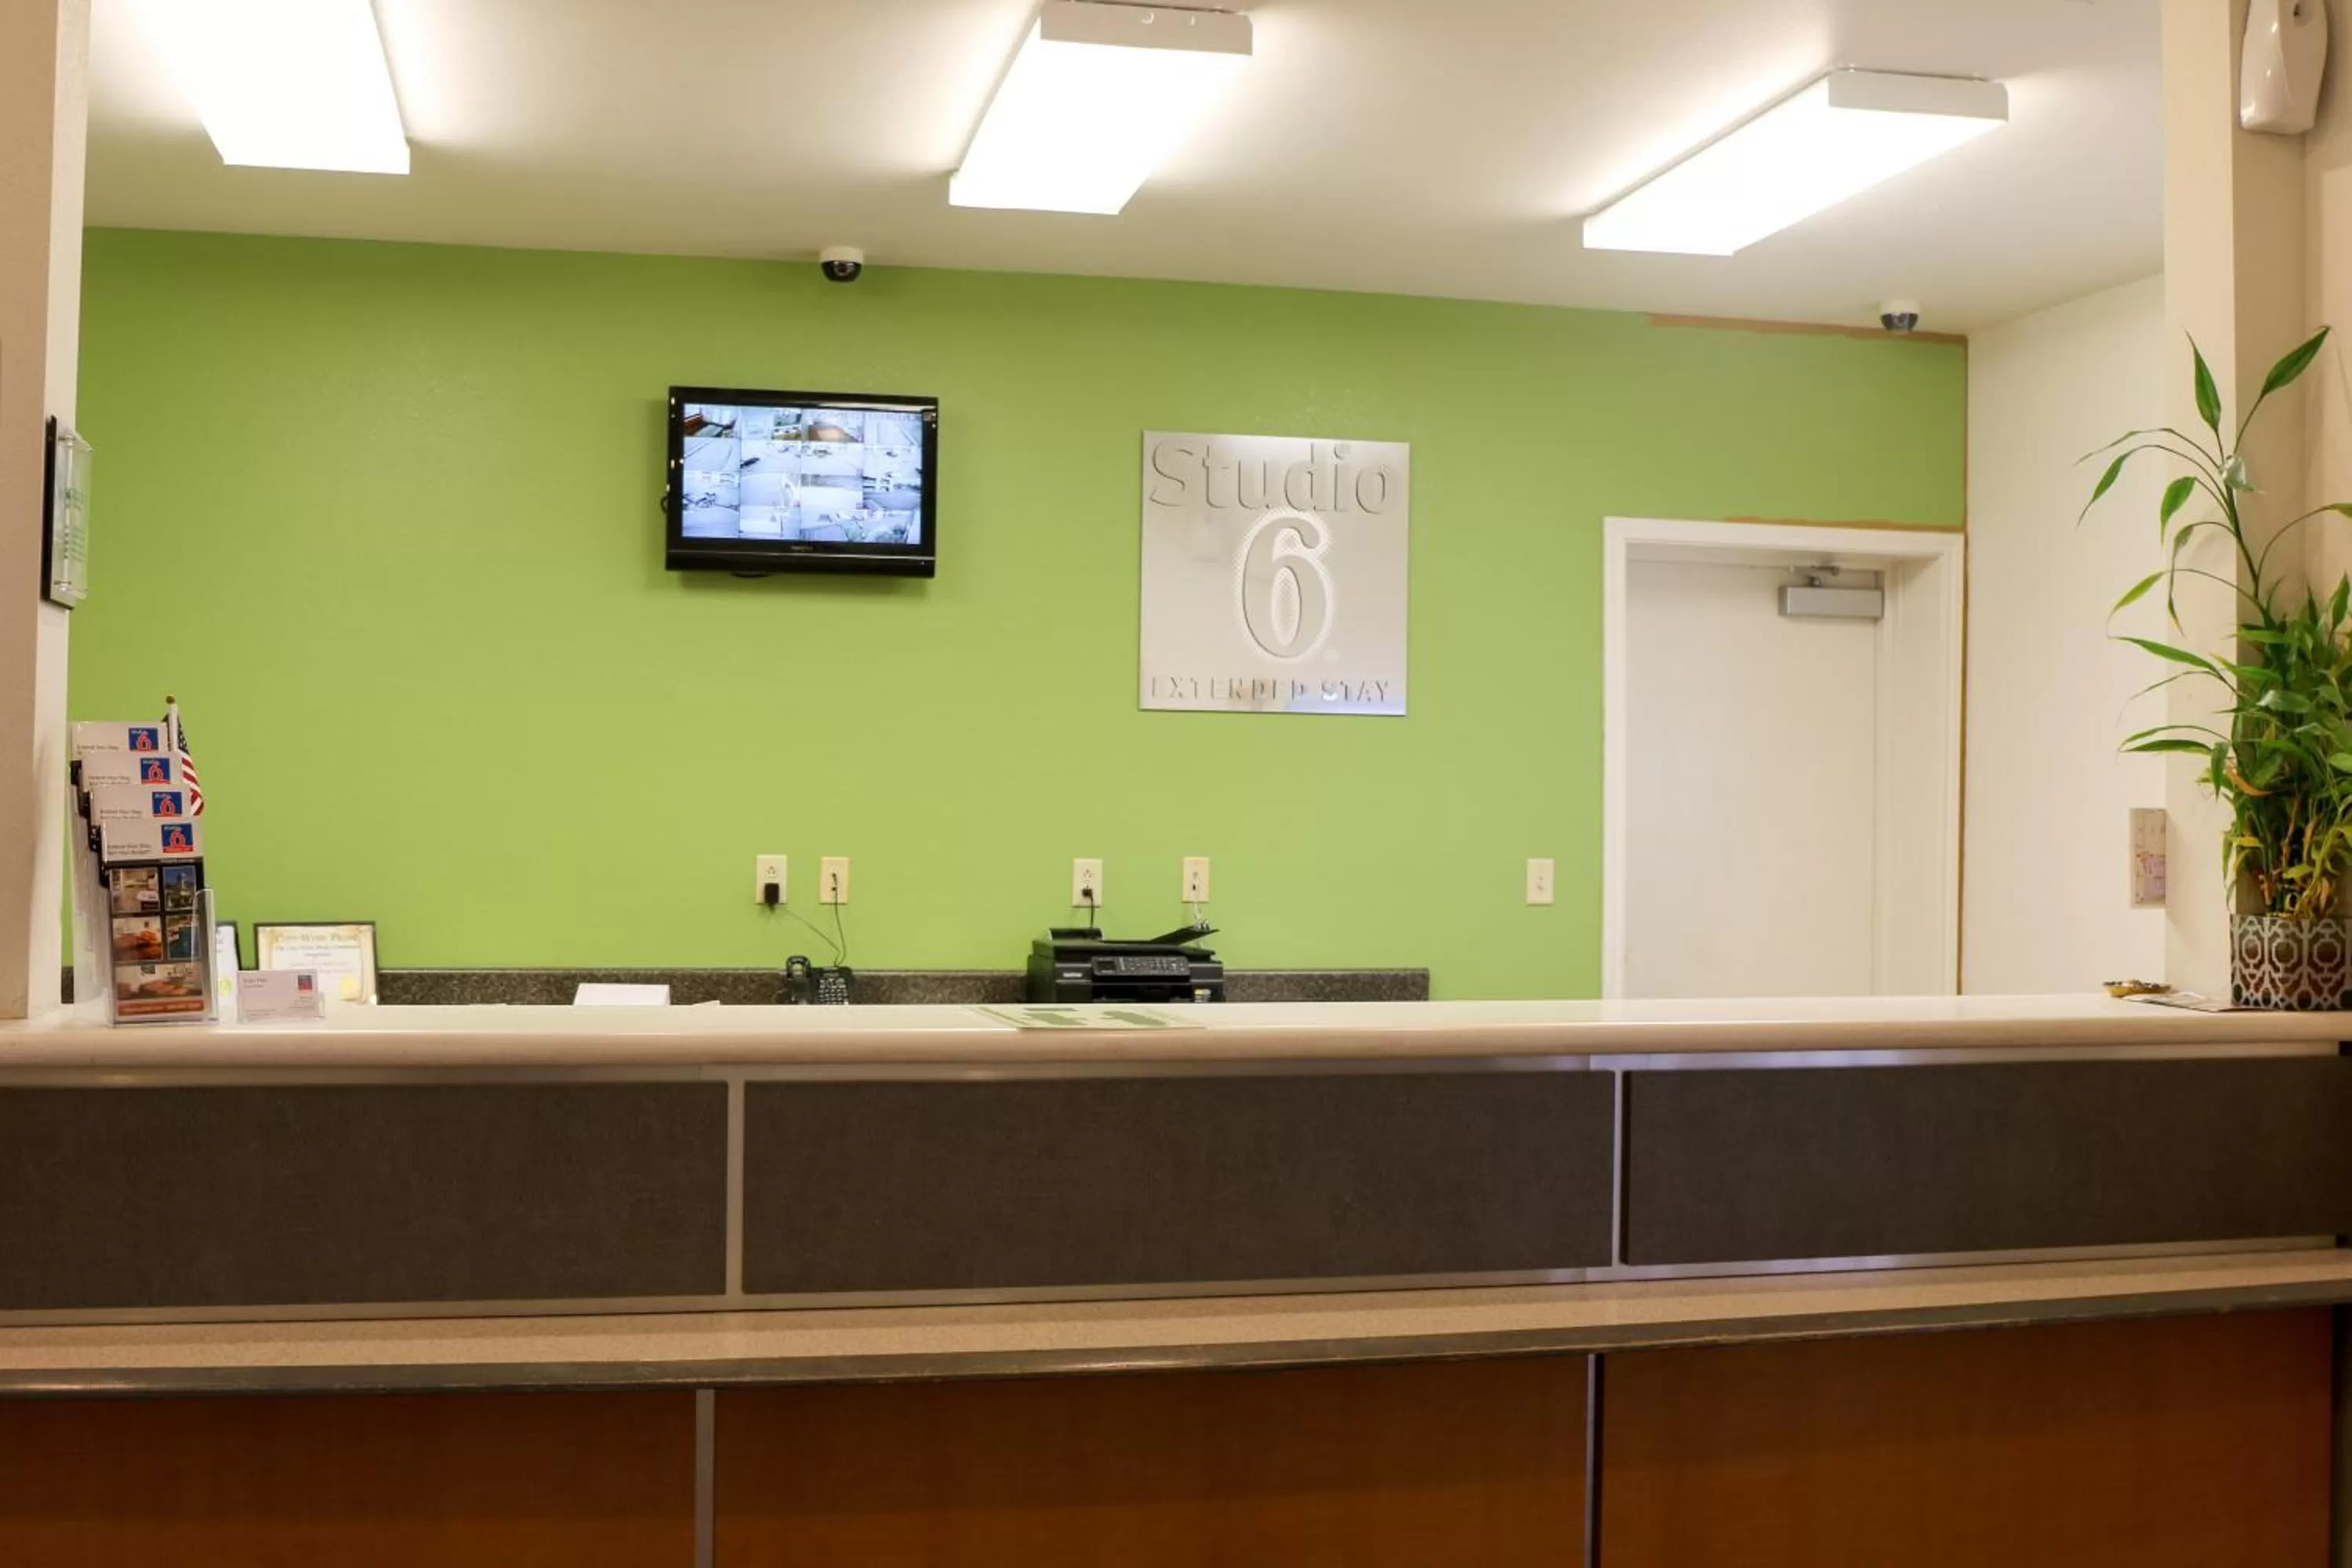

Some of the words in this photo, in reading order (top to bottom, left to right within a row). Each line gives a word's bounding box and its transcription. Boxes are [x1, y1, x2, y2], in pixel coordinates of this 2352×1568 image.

[1149, 441, 1391, 514] Studio
[1240, 514, 1330, 659] 6
[1151, 676, 1308, 702] EXTENDED
[1320, 678, 1389, 702] STAY
